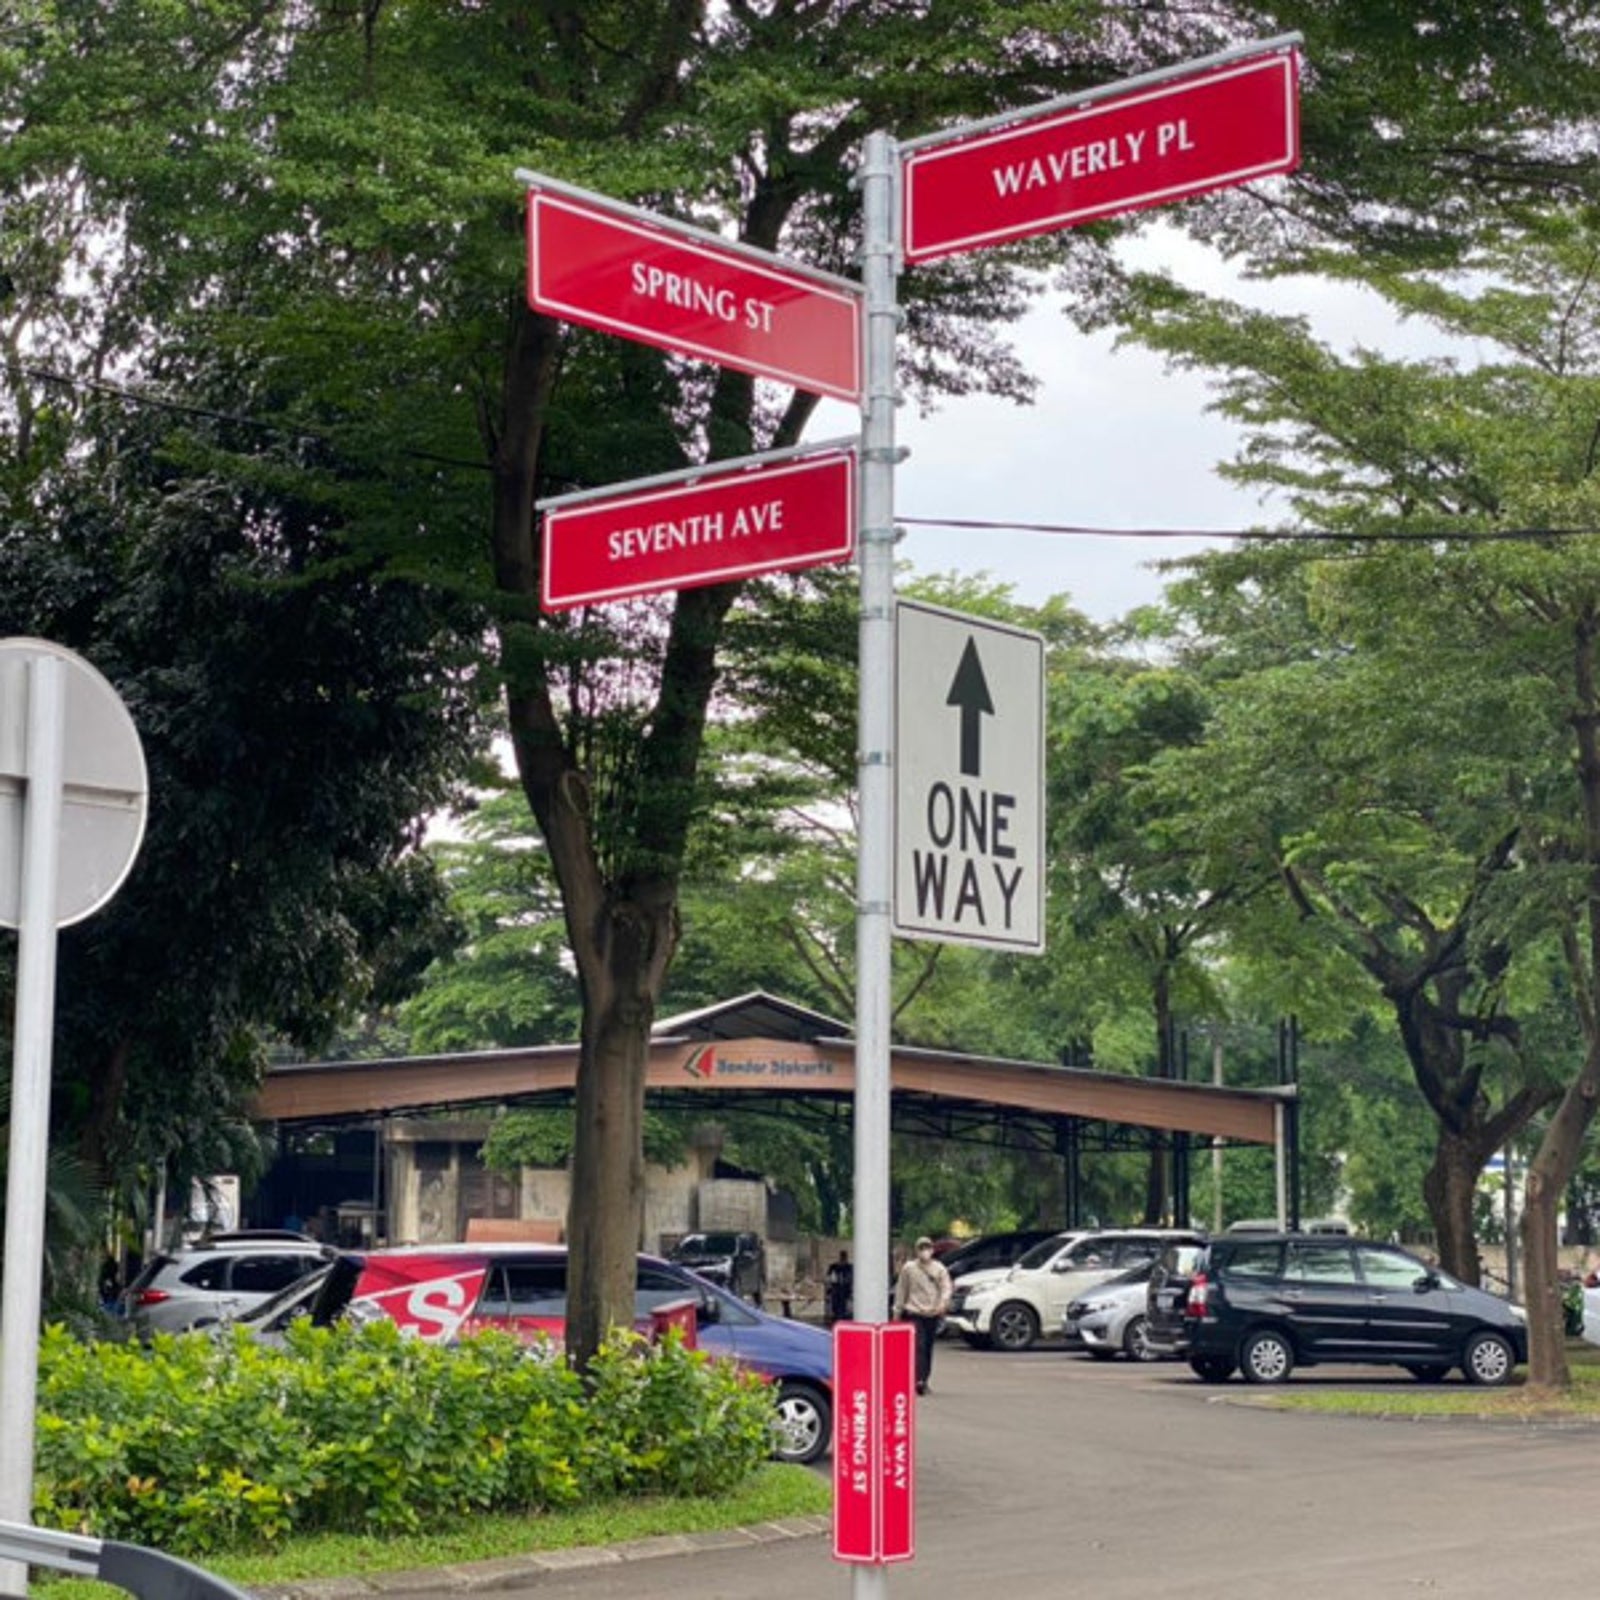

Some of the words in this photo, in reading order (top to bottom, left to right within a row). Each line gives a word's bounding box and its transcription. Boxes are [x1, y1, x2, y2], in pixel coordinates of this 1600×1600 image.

[992, 130, 1145, 197] WAVERLY
[1157, 119, 1195, 156] PL
[631, 261, 737, 322] SPRING
[745, 298, 775, 332] ST
[608, 512, 724, 561] SEVENTH
[730, 500, 784, 538] AVE
[927, 781, 1017, 860] ONE
[913, 850, 1023, 929] WAY
[853, 1390, 868, 1465] SPRING
[894, 1393, 908, 1436] ONE
[853, 1470, 868, 1494] ST
[894, 1442, 908, 1490] WAY
